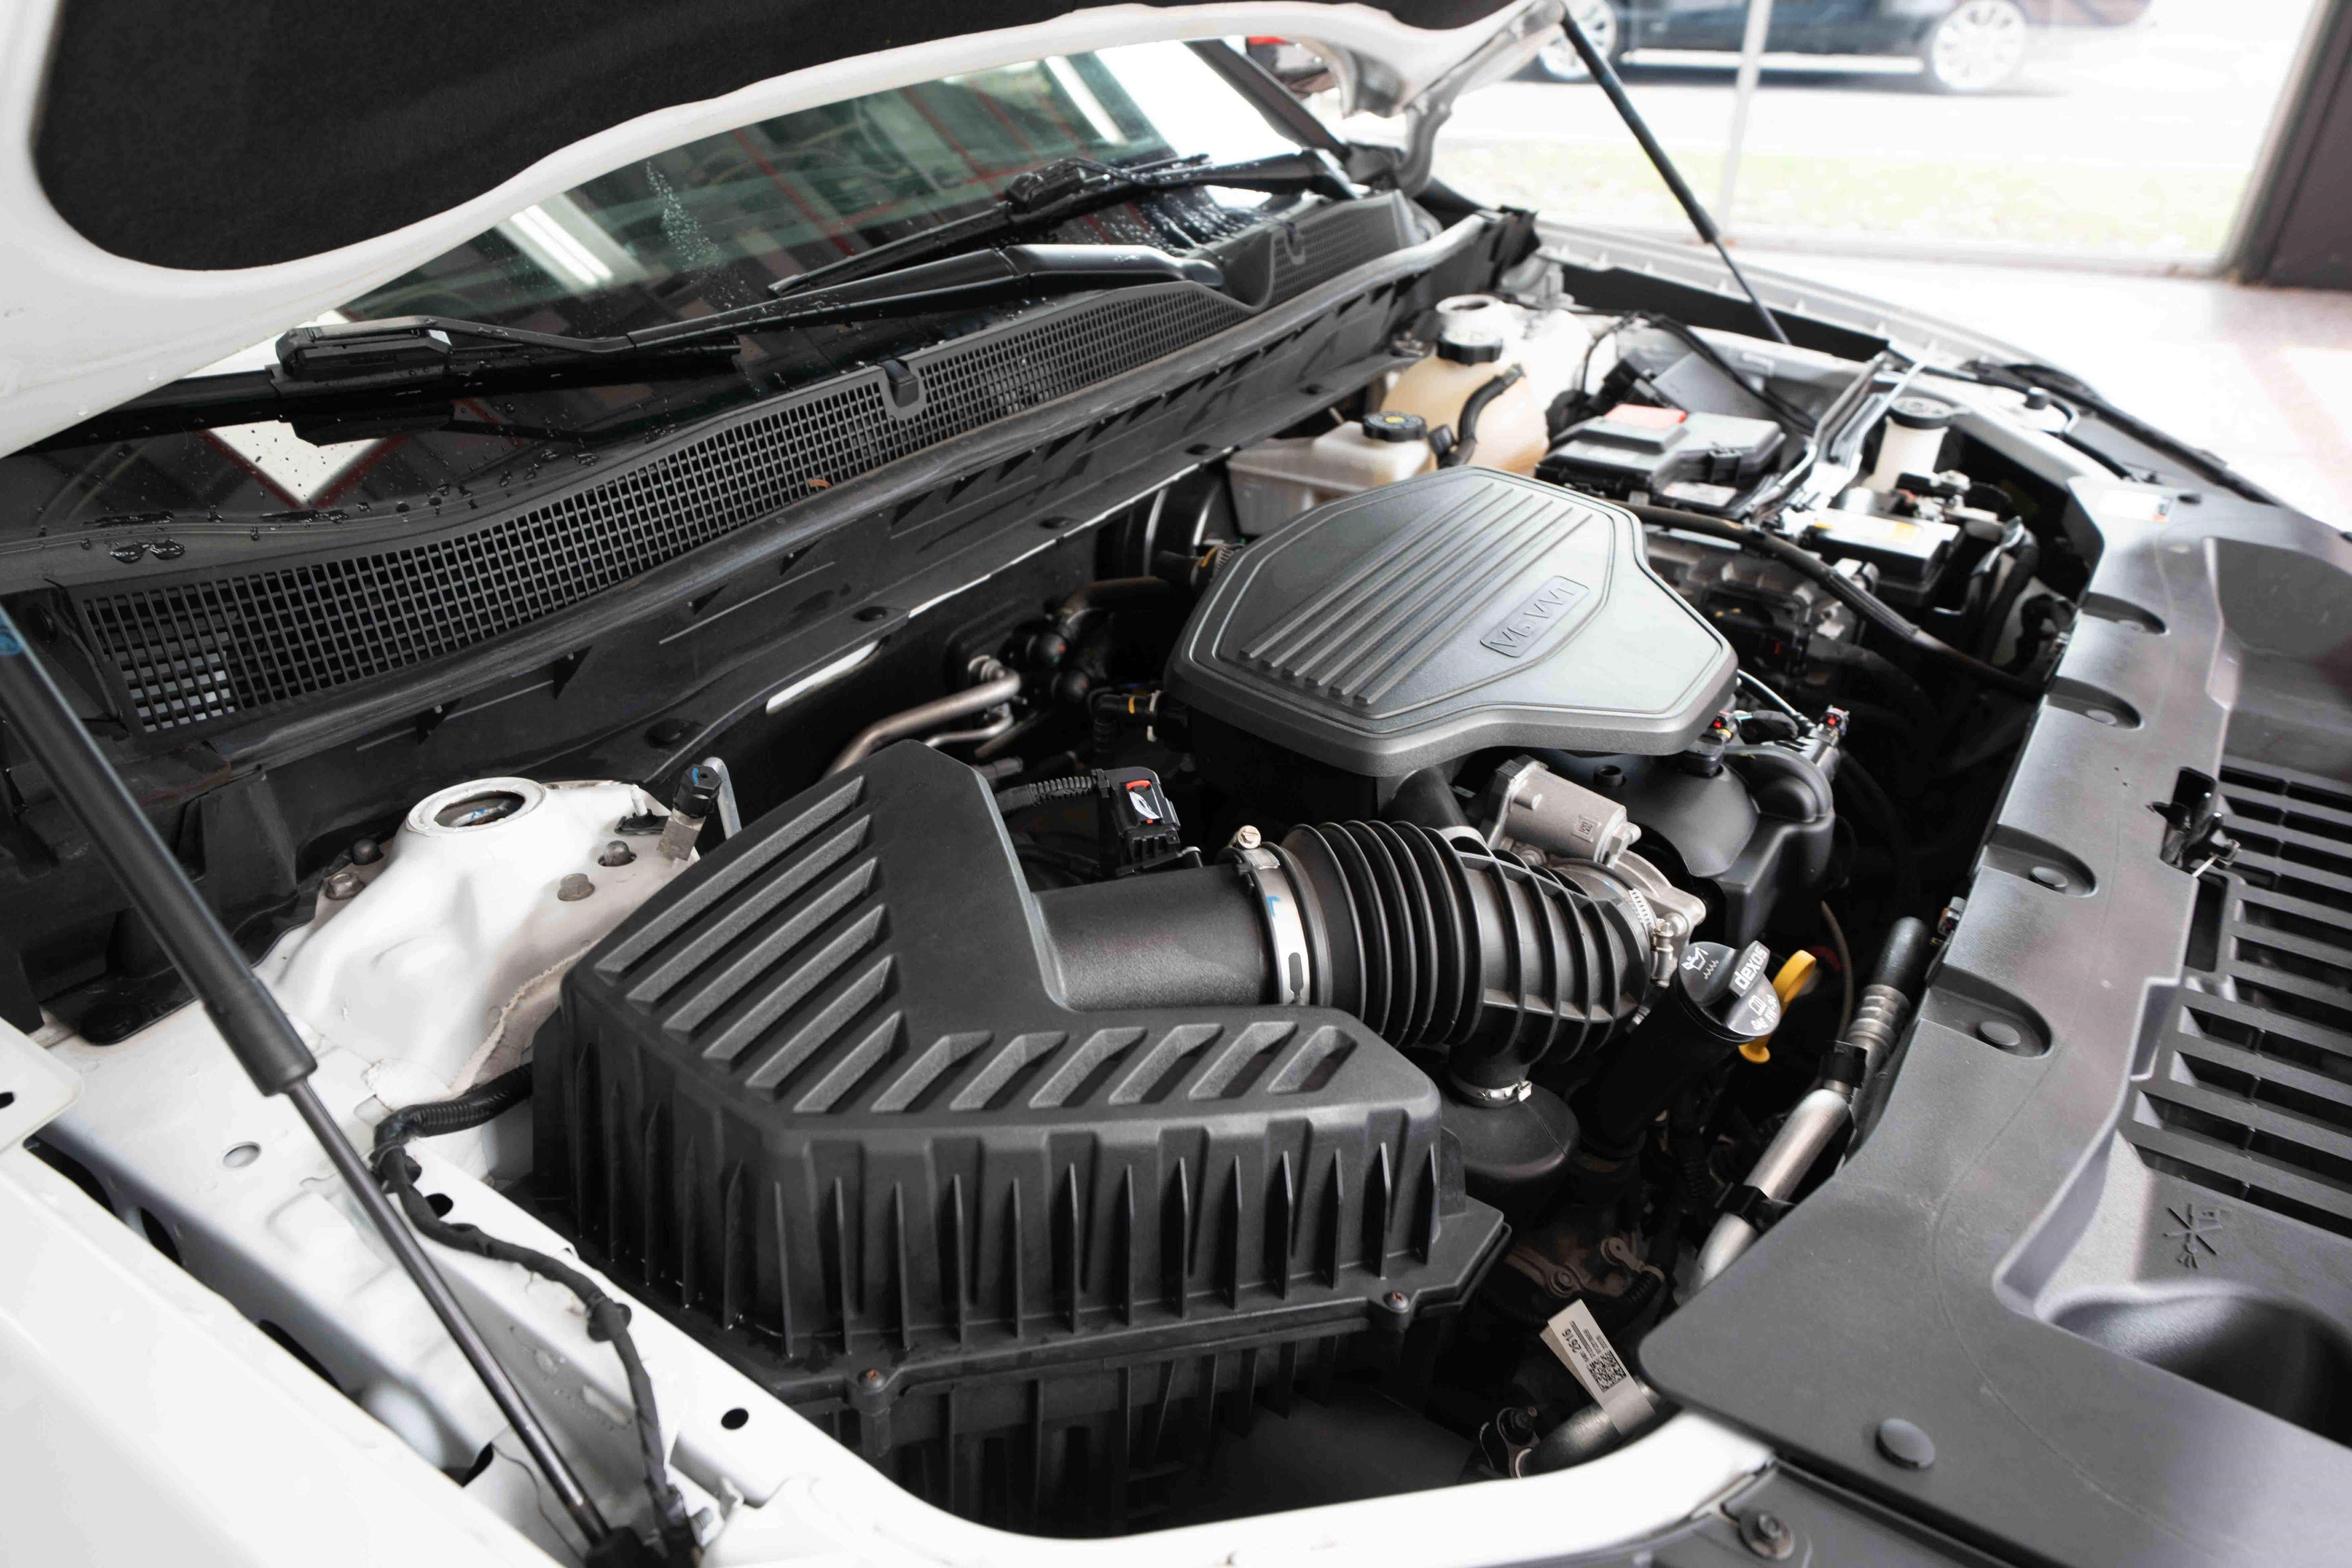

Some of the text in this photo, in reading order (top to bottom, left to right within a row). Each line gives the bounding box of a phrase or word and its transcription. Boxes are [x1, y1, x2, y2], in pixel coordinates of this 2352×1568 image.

[1489, 583, 1576, 648] V6 VVT
[1734, 945, 1768, 990] dexos
